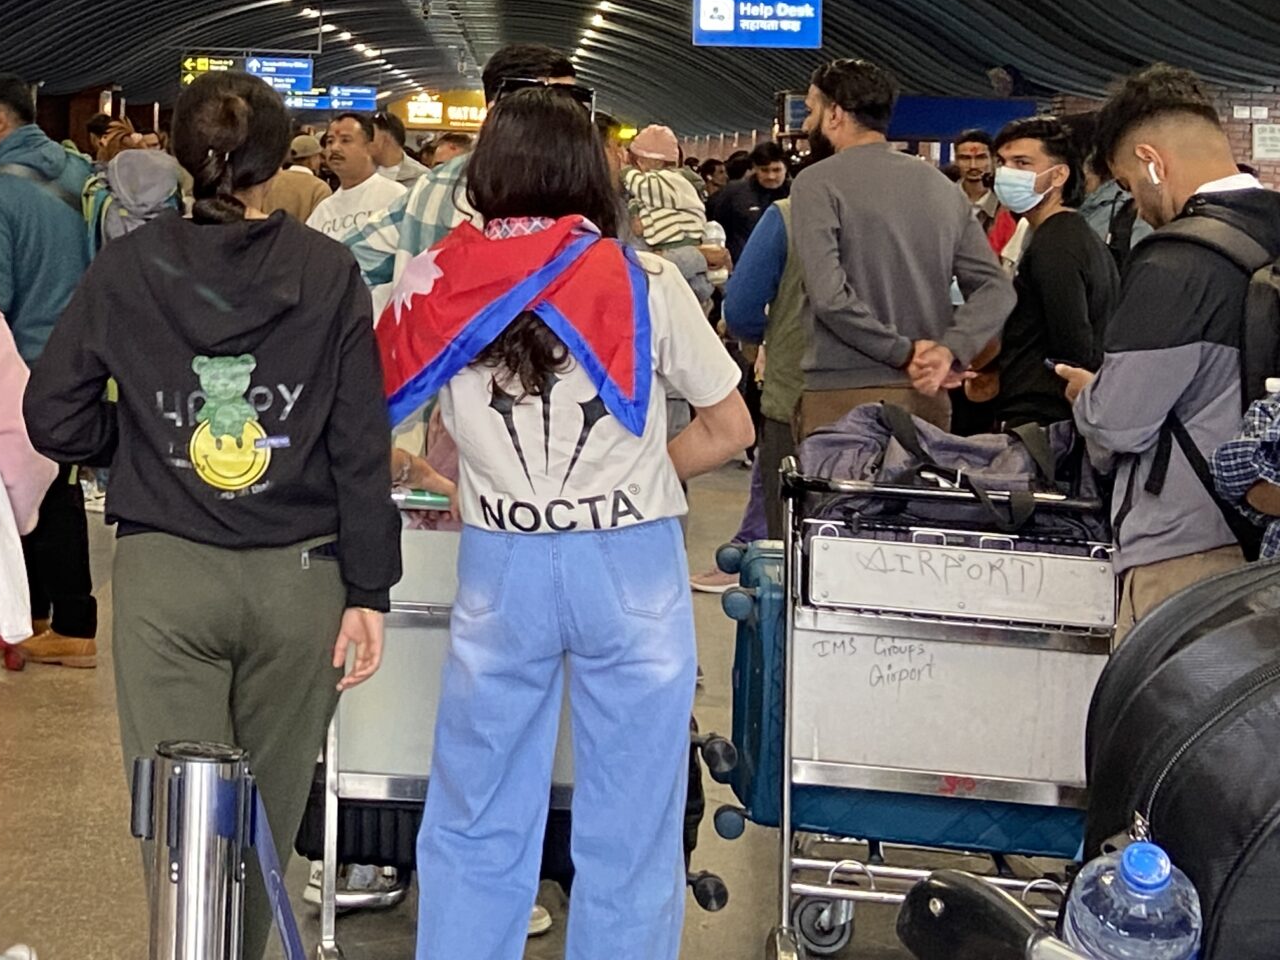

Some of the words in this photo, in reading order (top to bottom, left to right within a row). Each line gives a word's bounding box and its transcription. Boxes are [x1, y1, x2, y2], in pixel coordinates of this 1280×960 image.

[739, 1, 774, 19] Help
[776, 2, 816, 18] Desk
[869, 652, 936, 694] Airport
